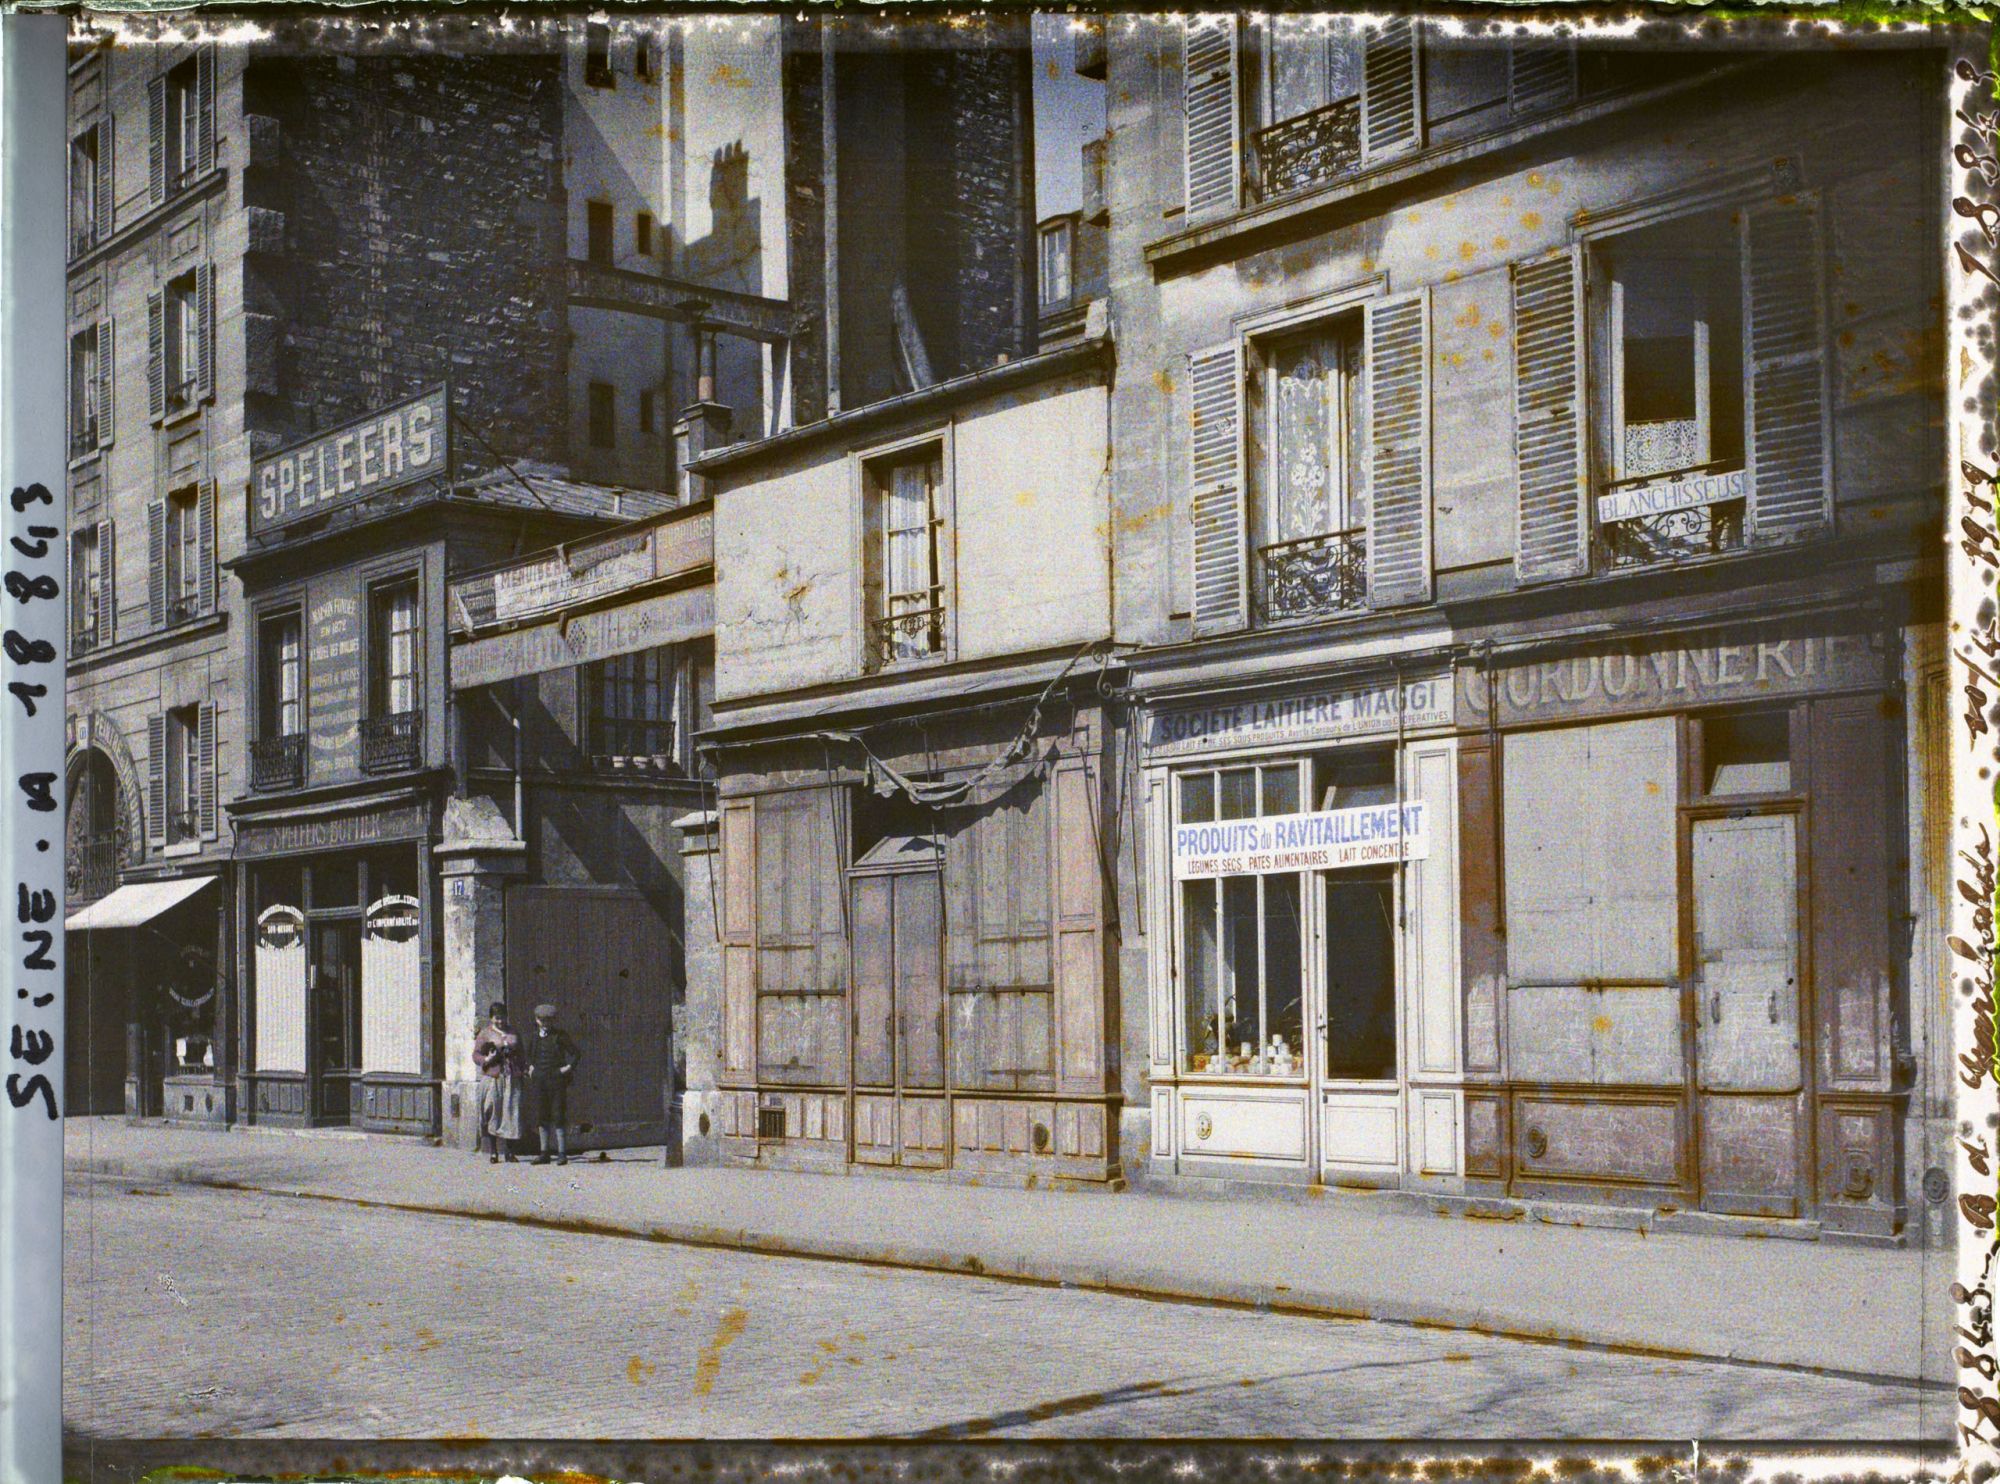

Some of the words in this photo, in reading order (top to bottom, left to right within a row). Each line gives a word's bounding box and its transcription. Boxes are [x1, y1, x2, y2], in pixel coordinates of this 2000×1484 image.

[260, 405, 432, 520] SPELEERS
[1177, 824, 1258, 857] PRODUITS
[1260, 828, 1272, 850] du
[1275, 805, 1423, 849] RAVITAILLEMENT
[1339, 846, 1356, 863] LAIT
[454, 881, 463, 896] 17
